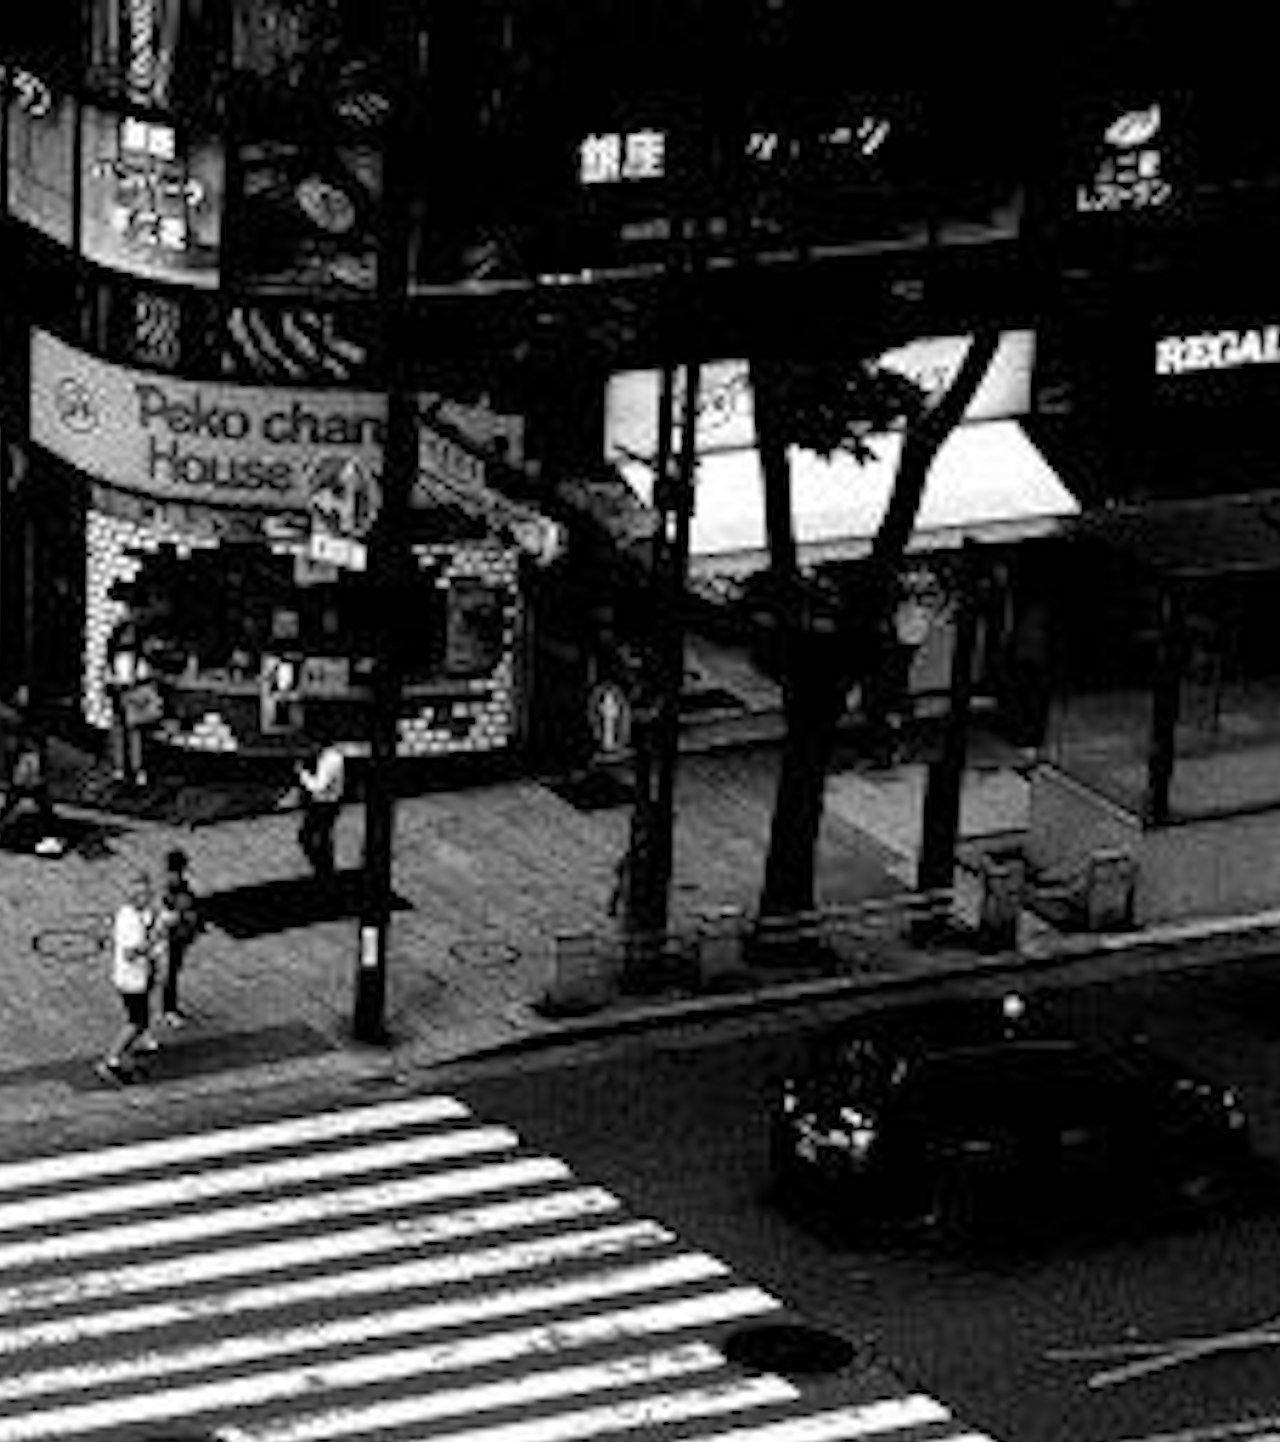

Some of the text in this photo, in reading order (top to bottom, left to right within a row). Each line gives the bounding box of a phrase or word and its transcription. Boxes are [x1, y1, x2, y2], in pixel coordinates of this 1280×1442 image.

[135, 383, 385, 445] Peko chan
[150, 434, 288, 490] House
